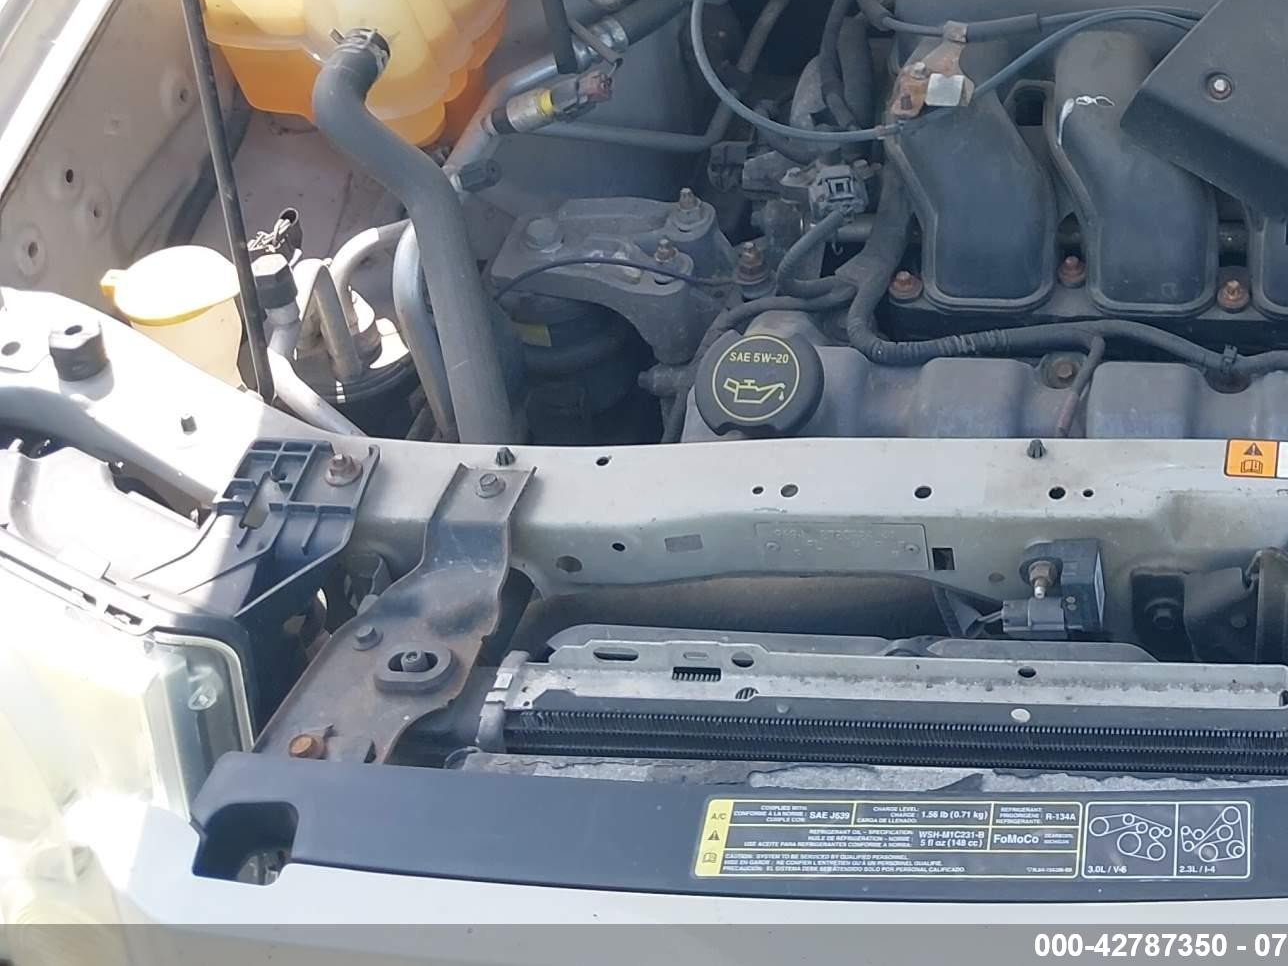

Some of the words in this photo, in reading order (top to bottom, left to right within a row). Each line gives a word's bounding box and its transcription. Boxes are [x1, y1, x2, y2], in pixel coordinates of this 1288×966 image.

[729, 352, 751, 362] SAE
[753, 352, 789, 364] 5W-20
[711, 813, 727, 821] A/C
[809, 811, 828, 819] SAE
[830, 811, 850, 820] J639
[949, 810, 971, 820] (0.71
[973, 810, 988, 820] kg)
[1045, 813, 1076, 821] R-134A
[993, 833, 1039, 844] FoMoCo
[968, 839, 982, 848] cc)
[1088, 865, 1106, 873] 3.0L
[1113, 865, 1127, 873] V-6
[1179, 865, 1198, 873] 2.3L
